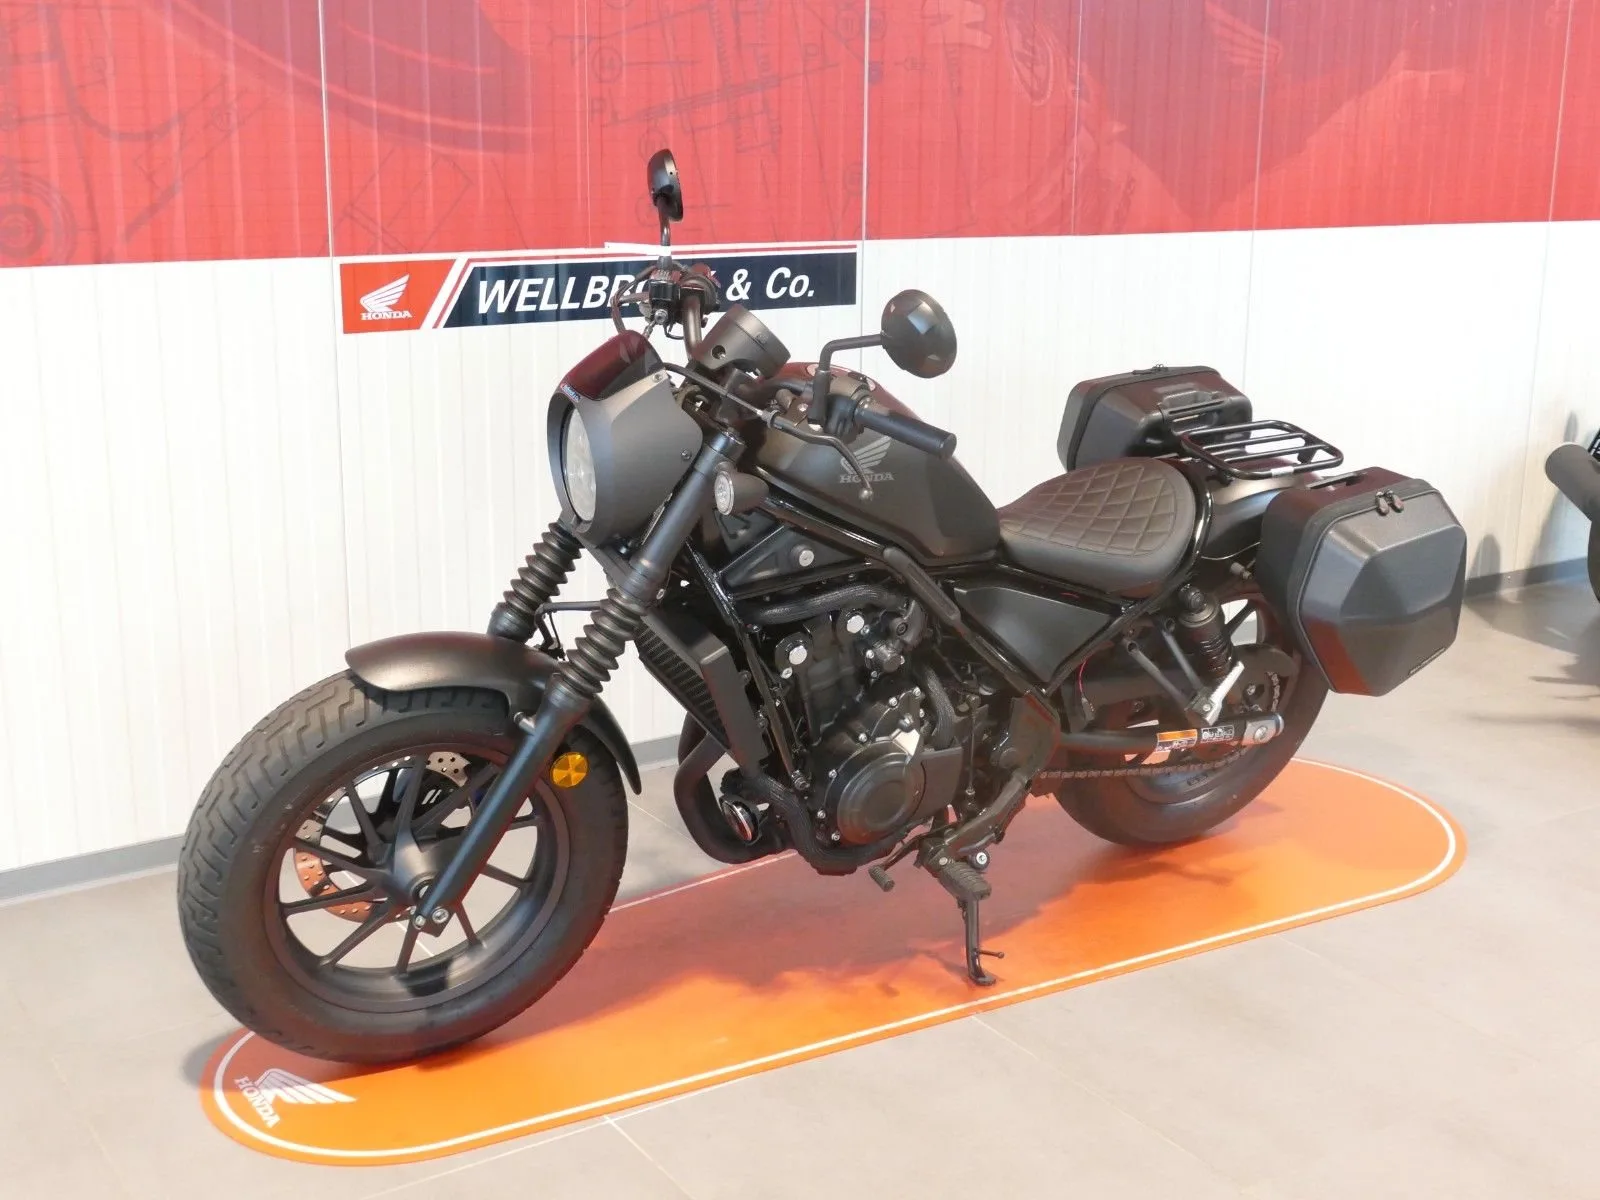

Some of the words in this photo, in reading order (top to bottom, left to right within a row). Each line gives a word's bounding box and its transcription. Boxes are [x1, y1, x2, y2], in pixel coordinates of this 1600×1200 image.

[478, 270, 717, 314] WELLBR
[726, 269, 752, 301] &
[766, 267, 815, 299] Co.
[360, 311, 413, 320] HONDA
[233, 1076, 281, 1128] HONDA
